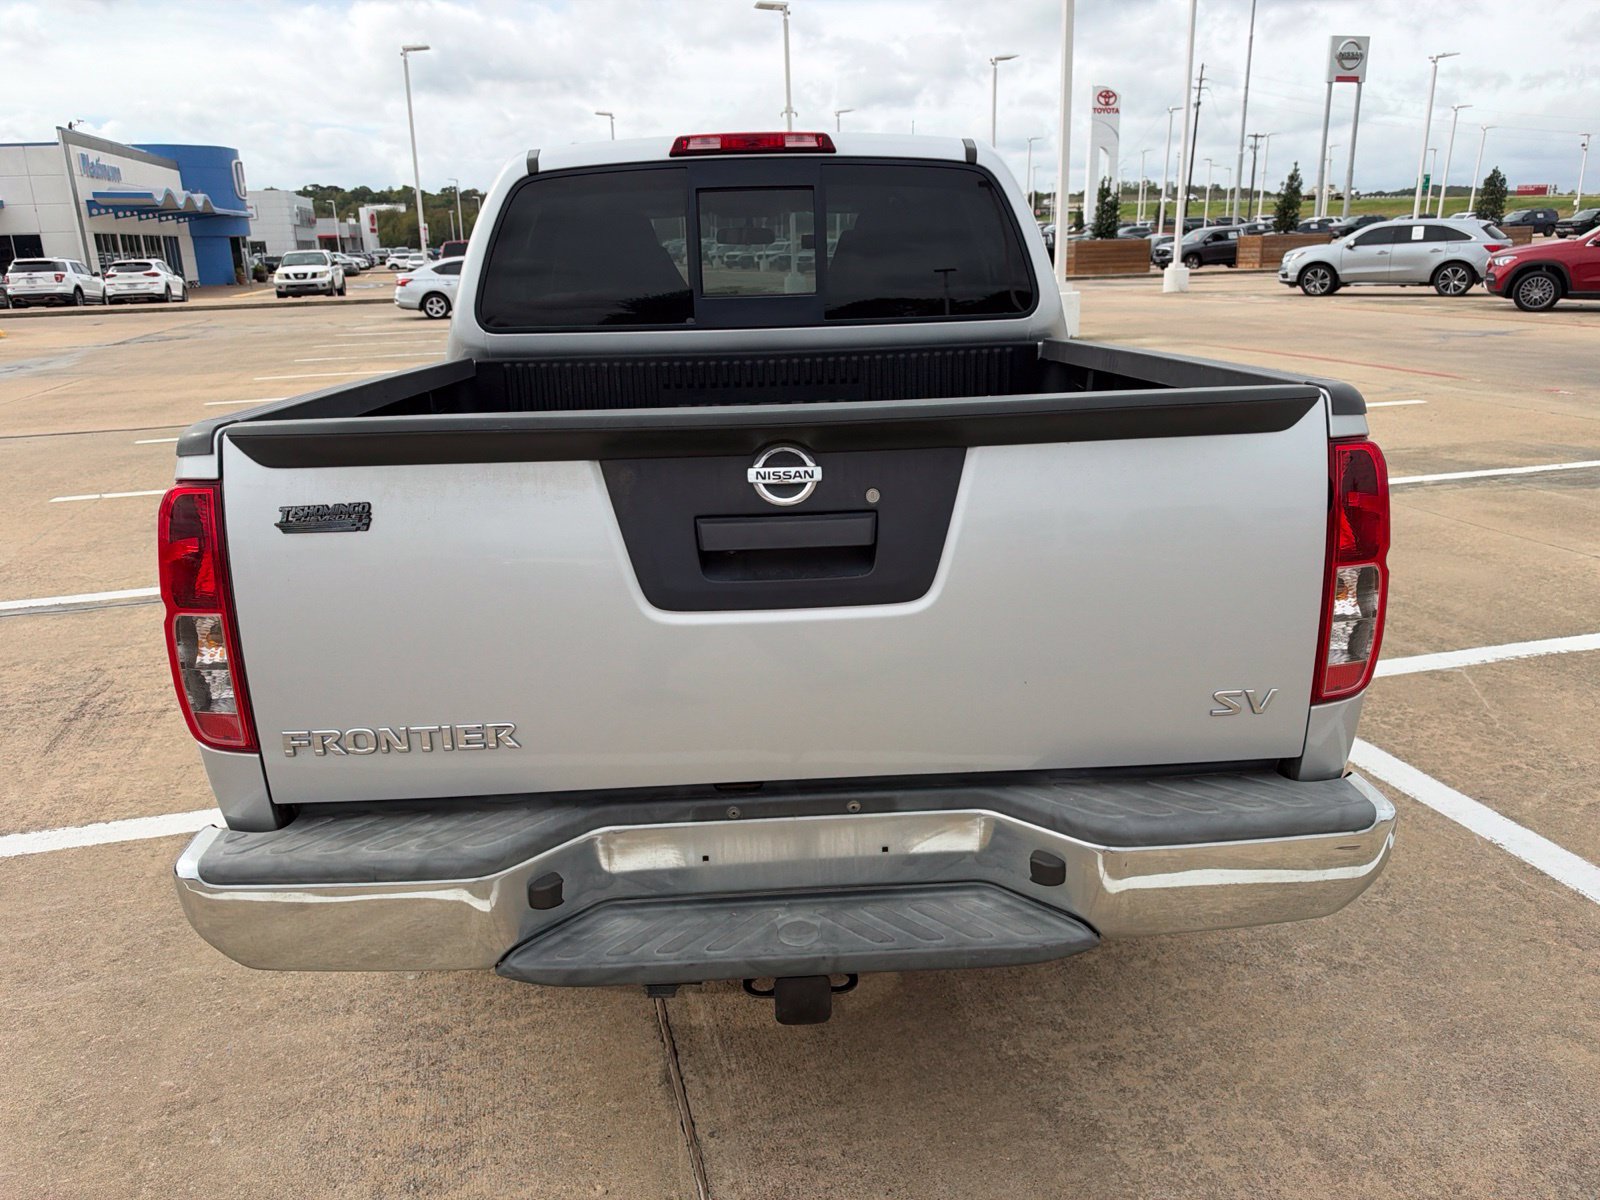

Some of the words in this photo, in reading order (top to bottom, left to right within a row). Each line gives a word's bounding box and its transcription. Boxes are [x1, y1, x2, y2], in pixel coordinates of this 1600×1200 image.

[755, 470, 815, 480] NISSAN
[278, 502, 371, 523] TISHOMINGO
[1210, 688, 1279, 716] SV
[281, 723, 521, 757] FRONTIER
